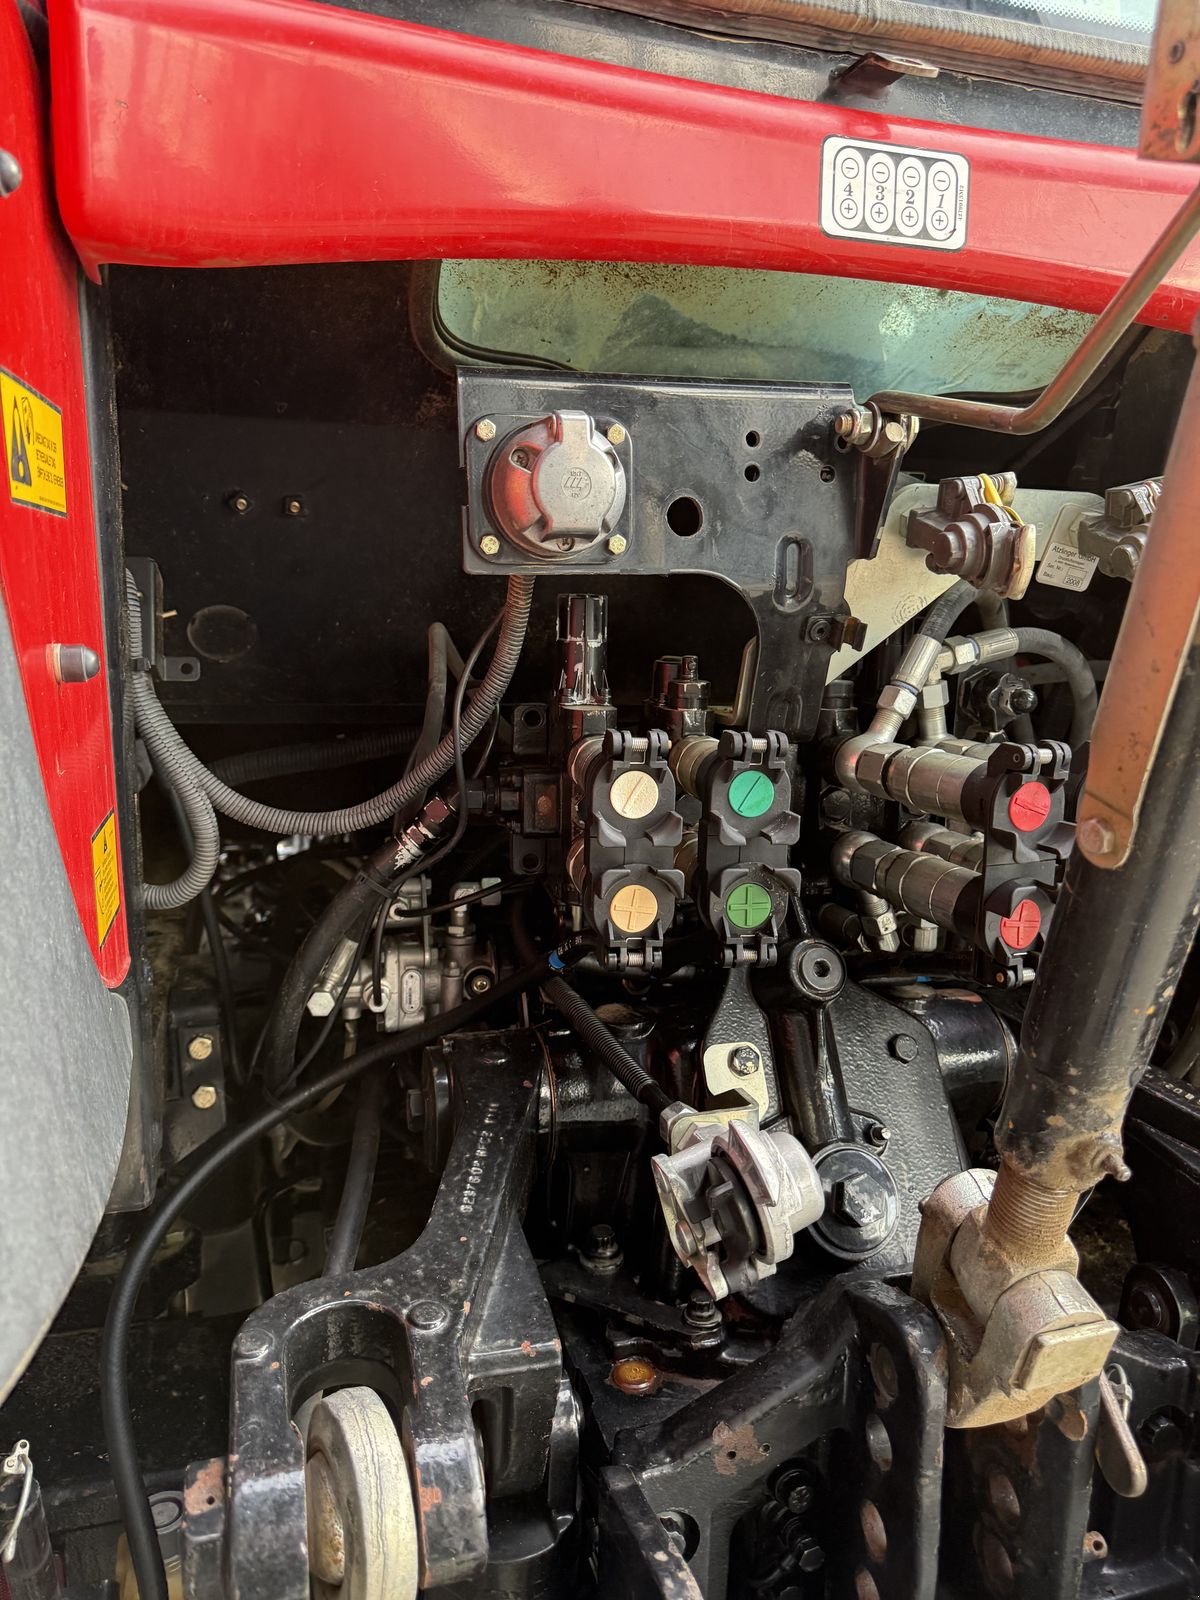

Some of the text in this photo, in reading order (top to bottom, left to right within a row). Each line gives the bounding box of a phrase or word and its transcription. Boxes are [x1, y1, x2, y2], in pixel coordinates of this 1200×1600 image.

[843, 182, 945, 209] 4 3 2 1
[1052, 545, 1077, 558] Atzlinger
